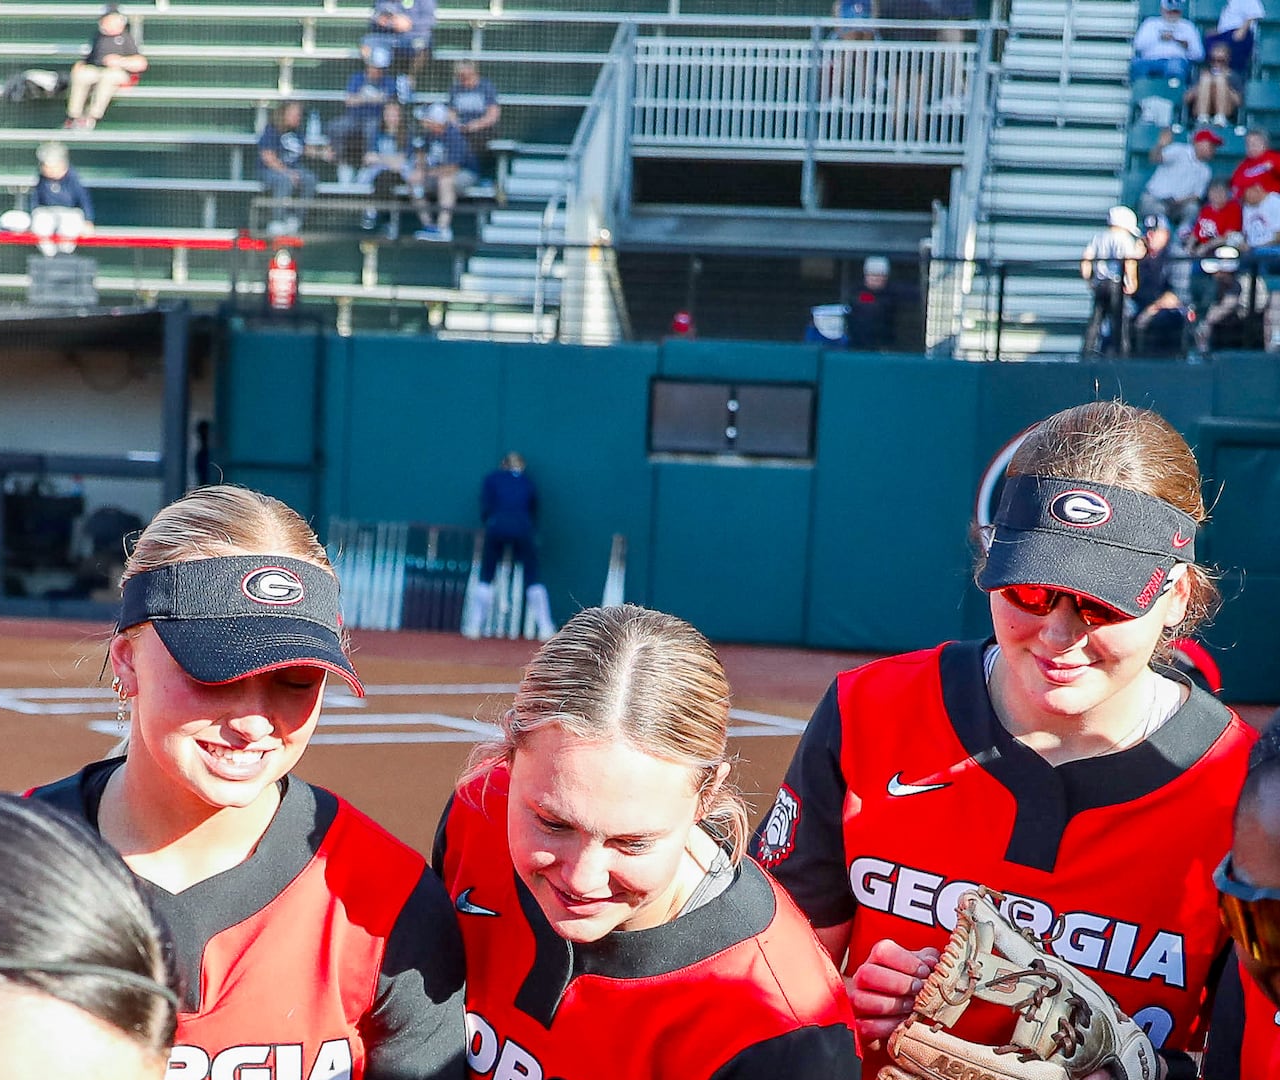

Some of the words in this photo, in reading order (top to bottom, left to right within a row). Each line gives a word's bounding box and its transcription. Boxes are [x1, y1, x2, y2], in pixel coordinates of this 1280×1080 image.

[1060, 493, 1109, 523] G
[256, 571, 303, 600] G
[1136, 566, 1166, 608] SOFTBALL
